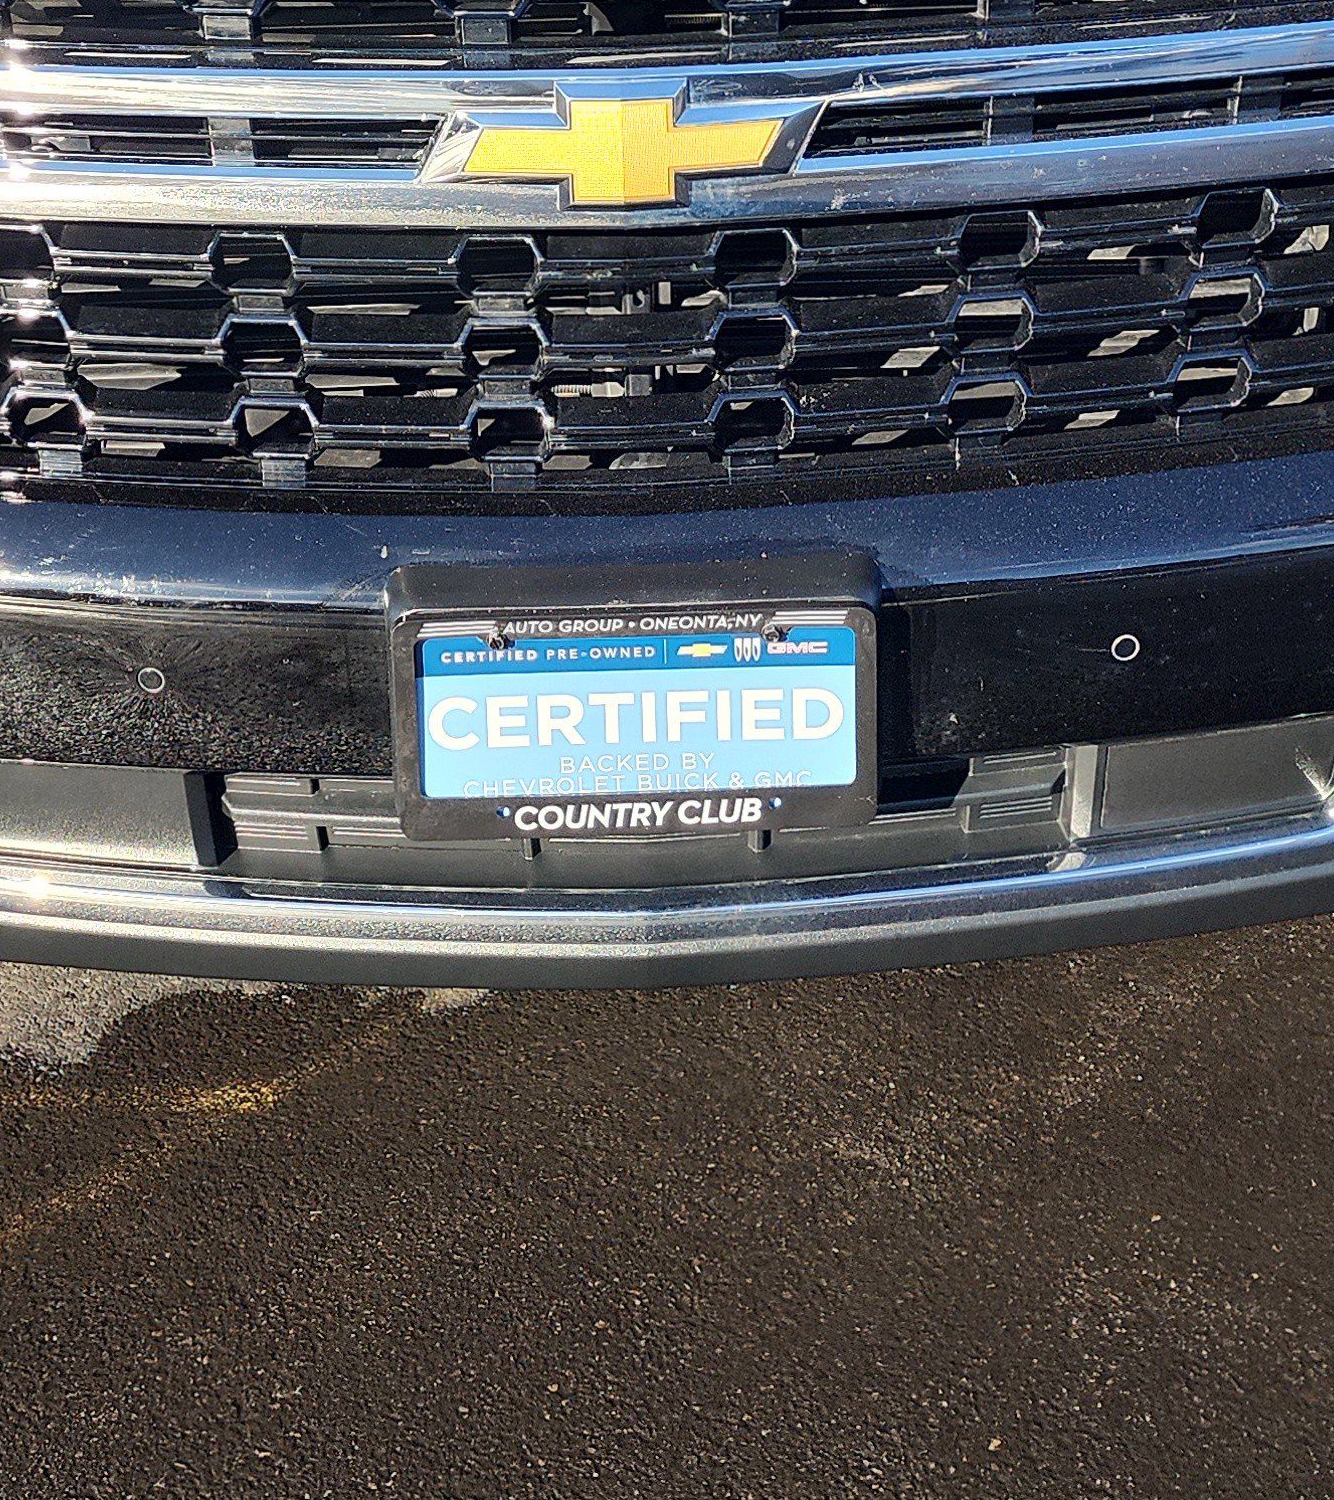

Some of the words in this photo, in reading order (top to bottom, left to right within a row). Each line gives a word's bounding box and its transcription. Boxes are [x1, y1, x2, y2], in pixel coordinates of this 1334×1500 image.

[502, 619, 554, 635] AUTO
[558, 617, 624, 633] GROUP
[440, 649, 539, 664] CERTIFIED
[545, 646, 656, 661] PRE-OWNED
[767, 641, 828, 654] GMC
[427, 687, 845, 752] CERTIFIED
[560, 753, 670, 774] BACKED
[681, 752, 716, 770] BY
[463, 775, 626, 798] CHEVROLET
[637, 772, 719, 792] BUICK
[728, 771, 744, 789] &
[754, 770, 812, 788] GMC
[514, 800, 673, 832] COUNTRY
[677, 797, 763, 825] CLUB
